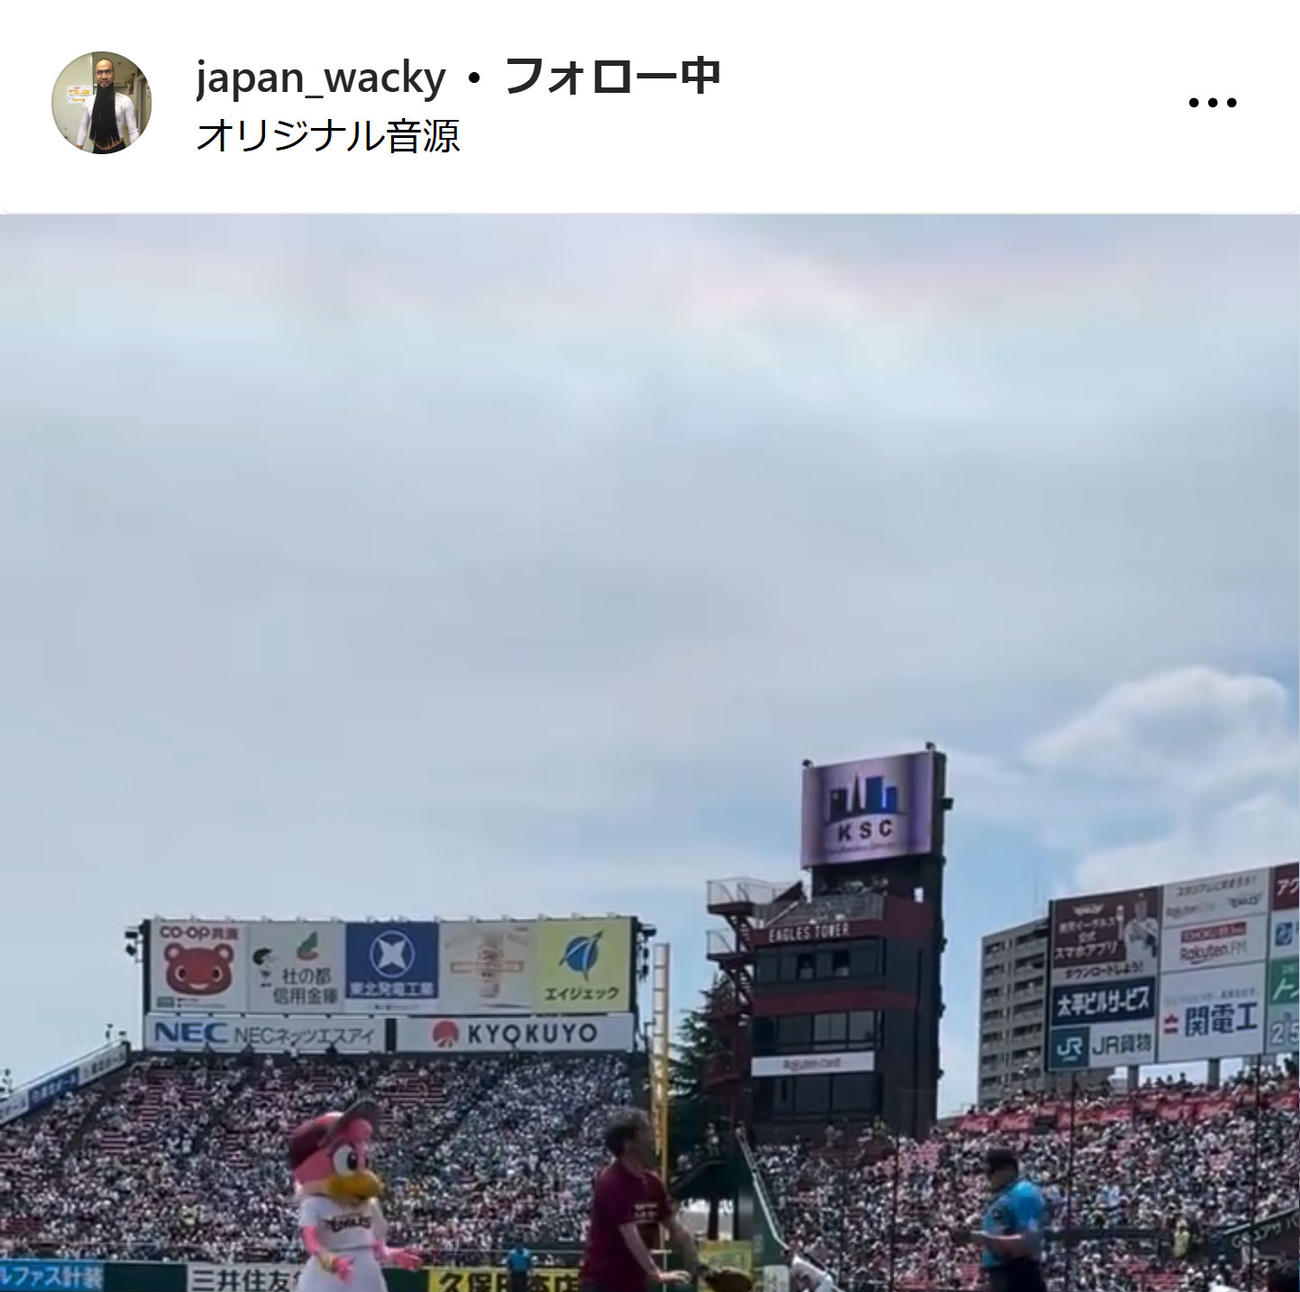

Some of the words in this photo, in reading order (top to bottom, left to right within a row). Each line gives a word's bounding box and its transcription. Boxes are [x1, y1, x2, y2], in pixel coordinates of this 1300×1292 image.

[769, 924, 811, 944] EAGLES
[815, 921, 850, 939] TOWER
[283, 967, 332, 986] 杜の都
[273, 987, 338, 1005] 信用金庫
[545, 985, 619, 1001] エイジェック
[1057, 985, 1150, 1017] 太平ビルサービス
[1185, 1001, 1259, 1038] 関電工
[155, 1022, 229, 1043] NEC
[234, 1026, 375, 1046] NECネッツエスアイ
[468, 1023, 598, 1044] KYOKUYO
[1056, 1037, 1083, 1056] JR
[1092, 1033, 1151, 1056] JR貨物
